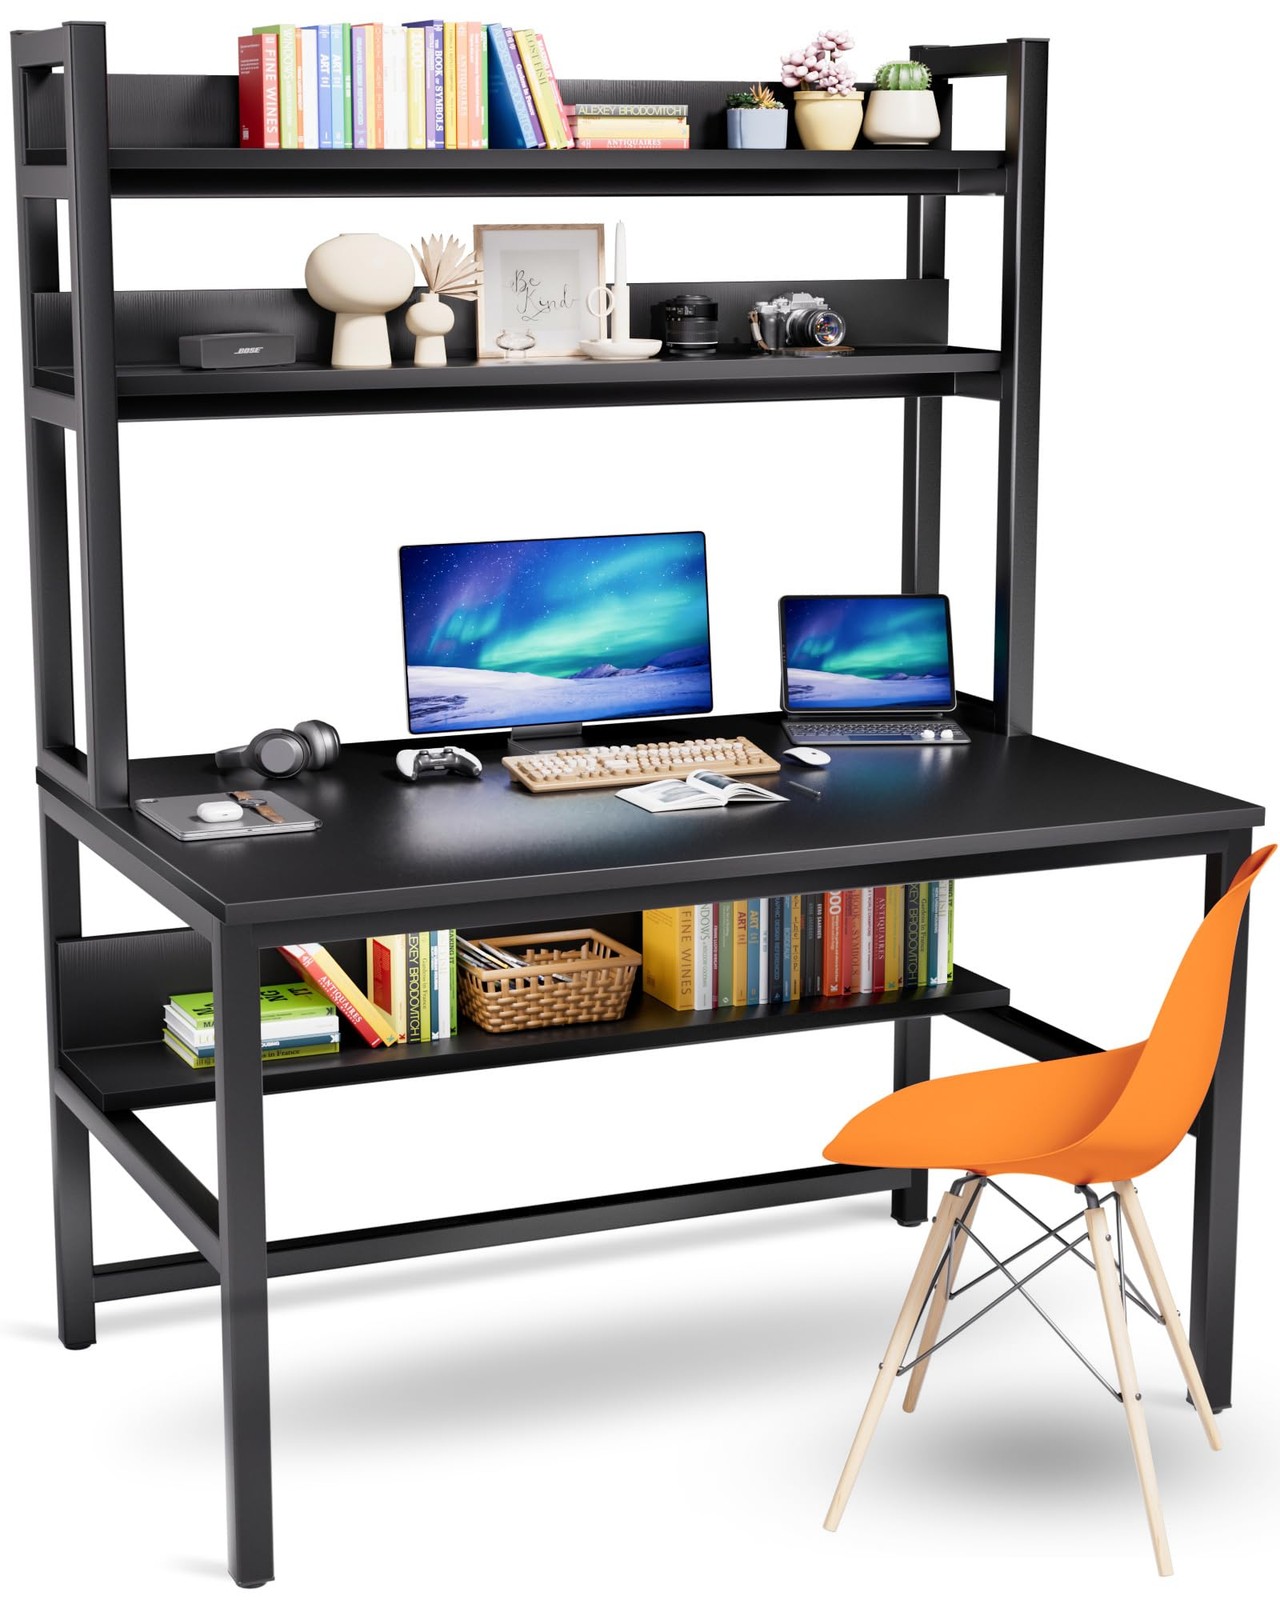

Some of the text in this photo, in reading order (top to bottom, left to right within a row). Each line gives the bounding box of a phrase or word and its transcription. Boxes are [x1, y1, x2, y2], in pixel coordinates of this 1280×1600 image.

[320, 54, 330, 73] ART
[332, 54, 342, 73] ART
[434, 50, 443, 77] BOOK
[525, 33, 548, 86] LOST FISH
[265, 48, 278, 133] FINE WINES
[516, 63, 528, 88] Gardens
[525, 96, 535, 116] France
[435, 86, 443, 131] SYMBOLS
[578, 105, 681, 116] ALEXEY BRODOVITCH
[511, 269, 541, 293] Be
[235, 346, 262, 355] BOSE
[700, 904, 711, 941] NDOWS
[737, 911, 747, 931] ART
[750, 910, 759, 929] ART
[852, 894, 860, 920] BOOK
[878, 897, 886, 960] ANTIQUAIRES
[909, 883, 919, 980] XEY BRODOVITCH
[681, 911, 692, 996] FINE WINES
[851, 929, 860, 976] SYMBOLS
[320, 975, 363, 1023] ANTIQUAIRES
[409, 934, 420, 1036] EXEY BRODOVITCH
[277, 1048, 300, 1057] France
